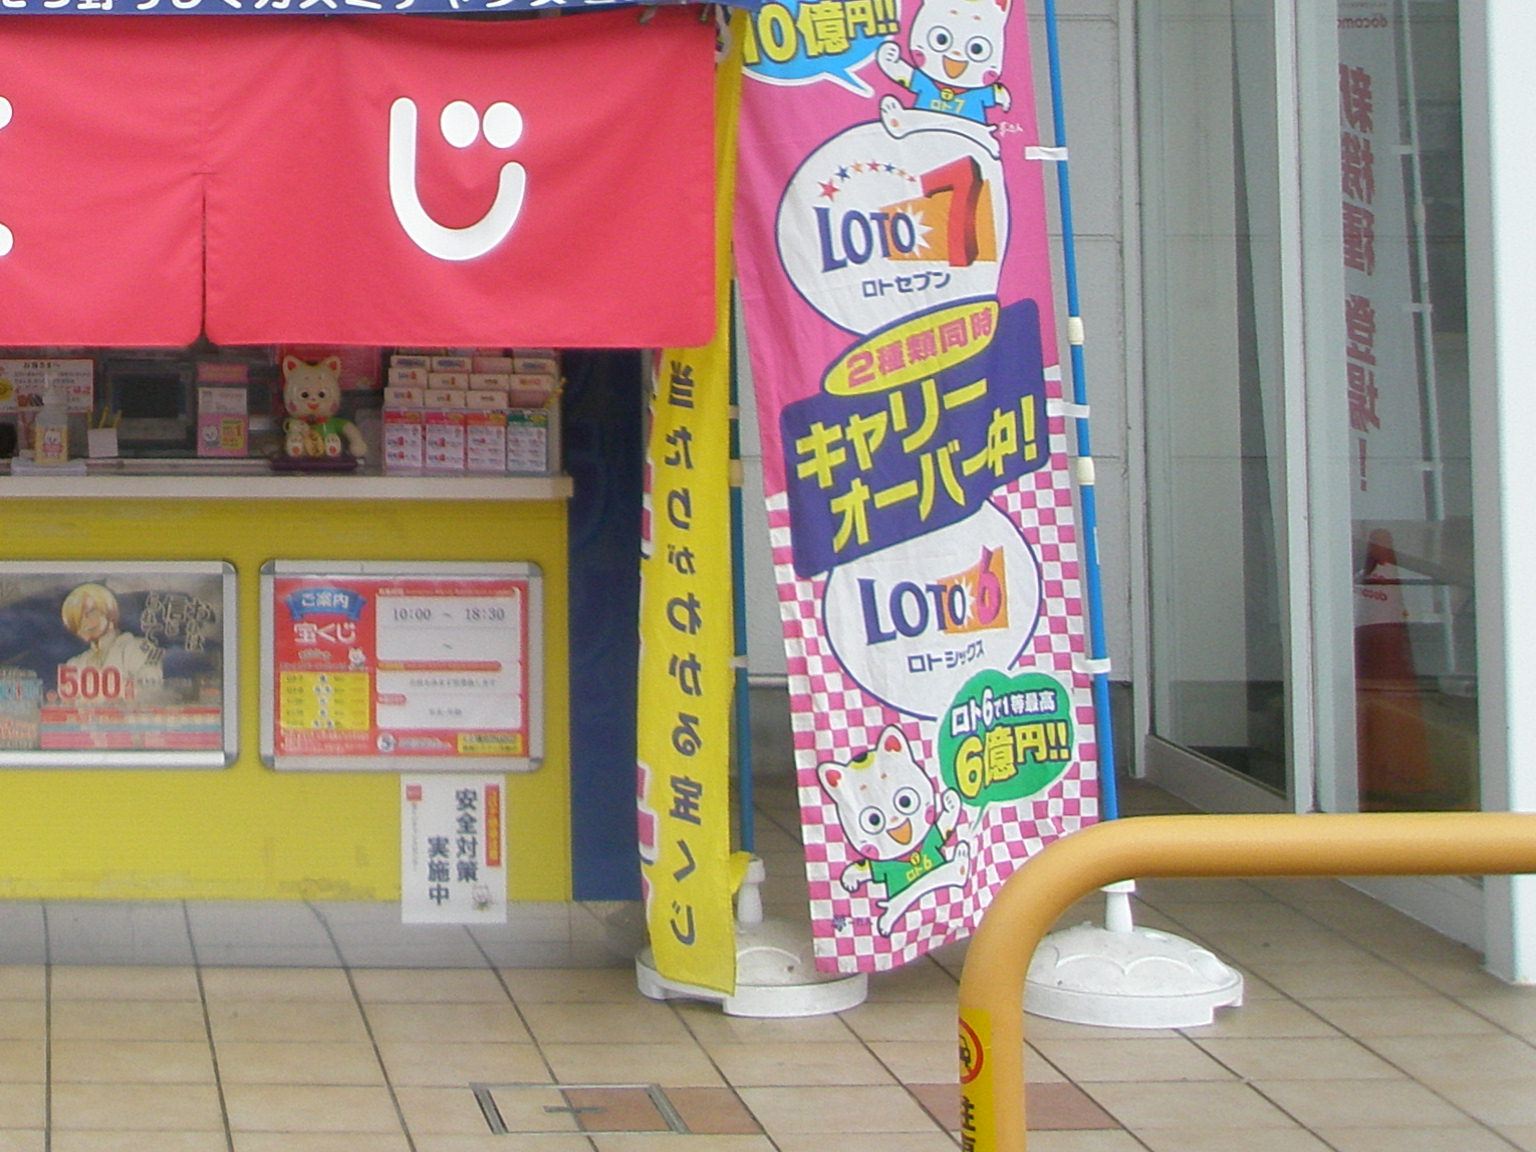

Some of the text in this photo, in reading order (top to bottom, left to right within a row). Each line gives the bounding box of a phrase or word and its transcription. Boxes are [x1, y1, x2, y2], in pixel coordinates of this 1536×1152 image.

[862, 270, 951, 299] ロトセブン
[845, 304, 994, 389] 2種類同時
[795, 377, 989, 490] キャリー
[294, 622, 356, 644] 宝くじ
[392, 607, 432, 621] 10:00
[465, 607, 506, 621] 18:30
[906, 639, 987, 674] ロトシックス
[455, 787, 478, 883] 安全対策
[427, 834, 450, 907] 実施中
